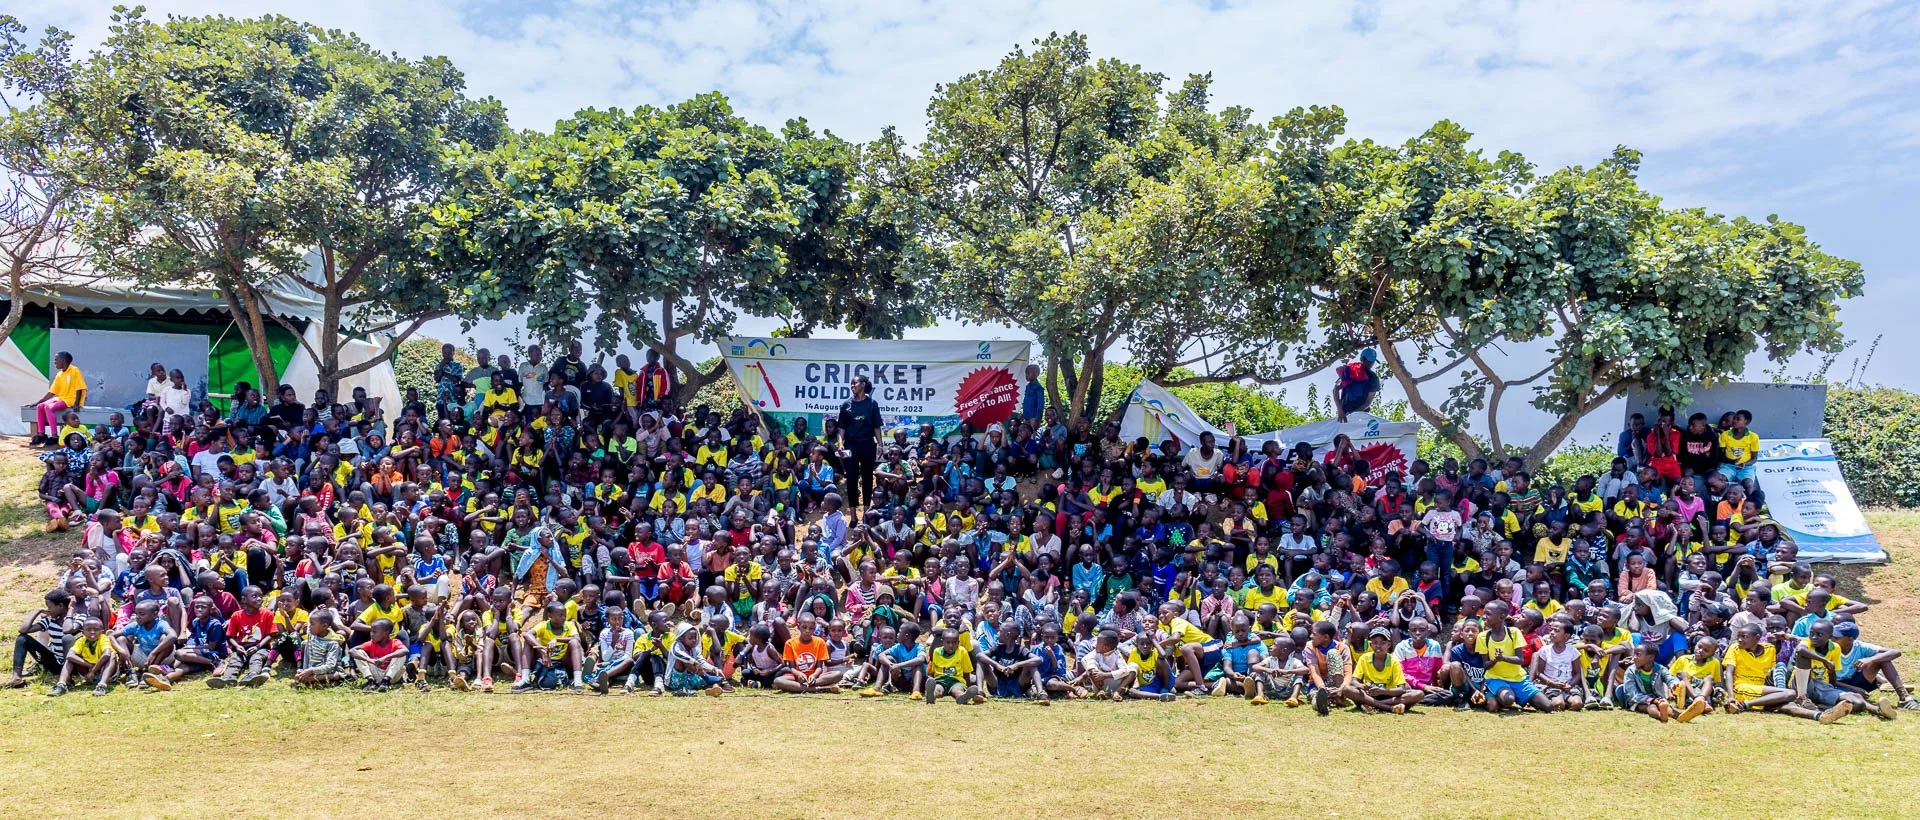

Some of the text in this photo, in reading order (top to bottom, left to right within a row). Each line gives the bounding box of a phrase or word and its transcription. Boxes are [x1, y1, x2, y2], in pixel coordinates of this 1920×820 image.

[805, 362, 927, 385] CRICKET
[794, 385, 936, 401] HOLIDY CAMP
[805, 403, 842, 411] 14Augus
[903, 405, 923, 413] 2023
[959, 398, 979, 410] Free
[986, 398, 996, 407] to
